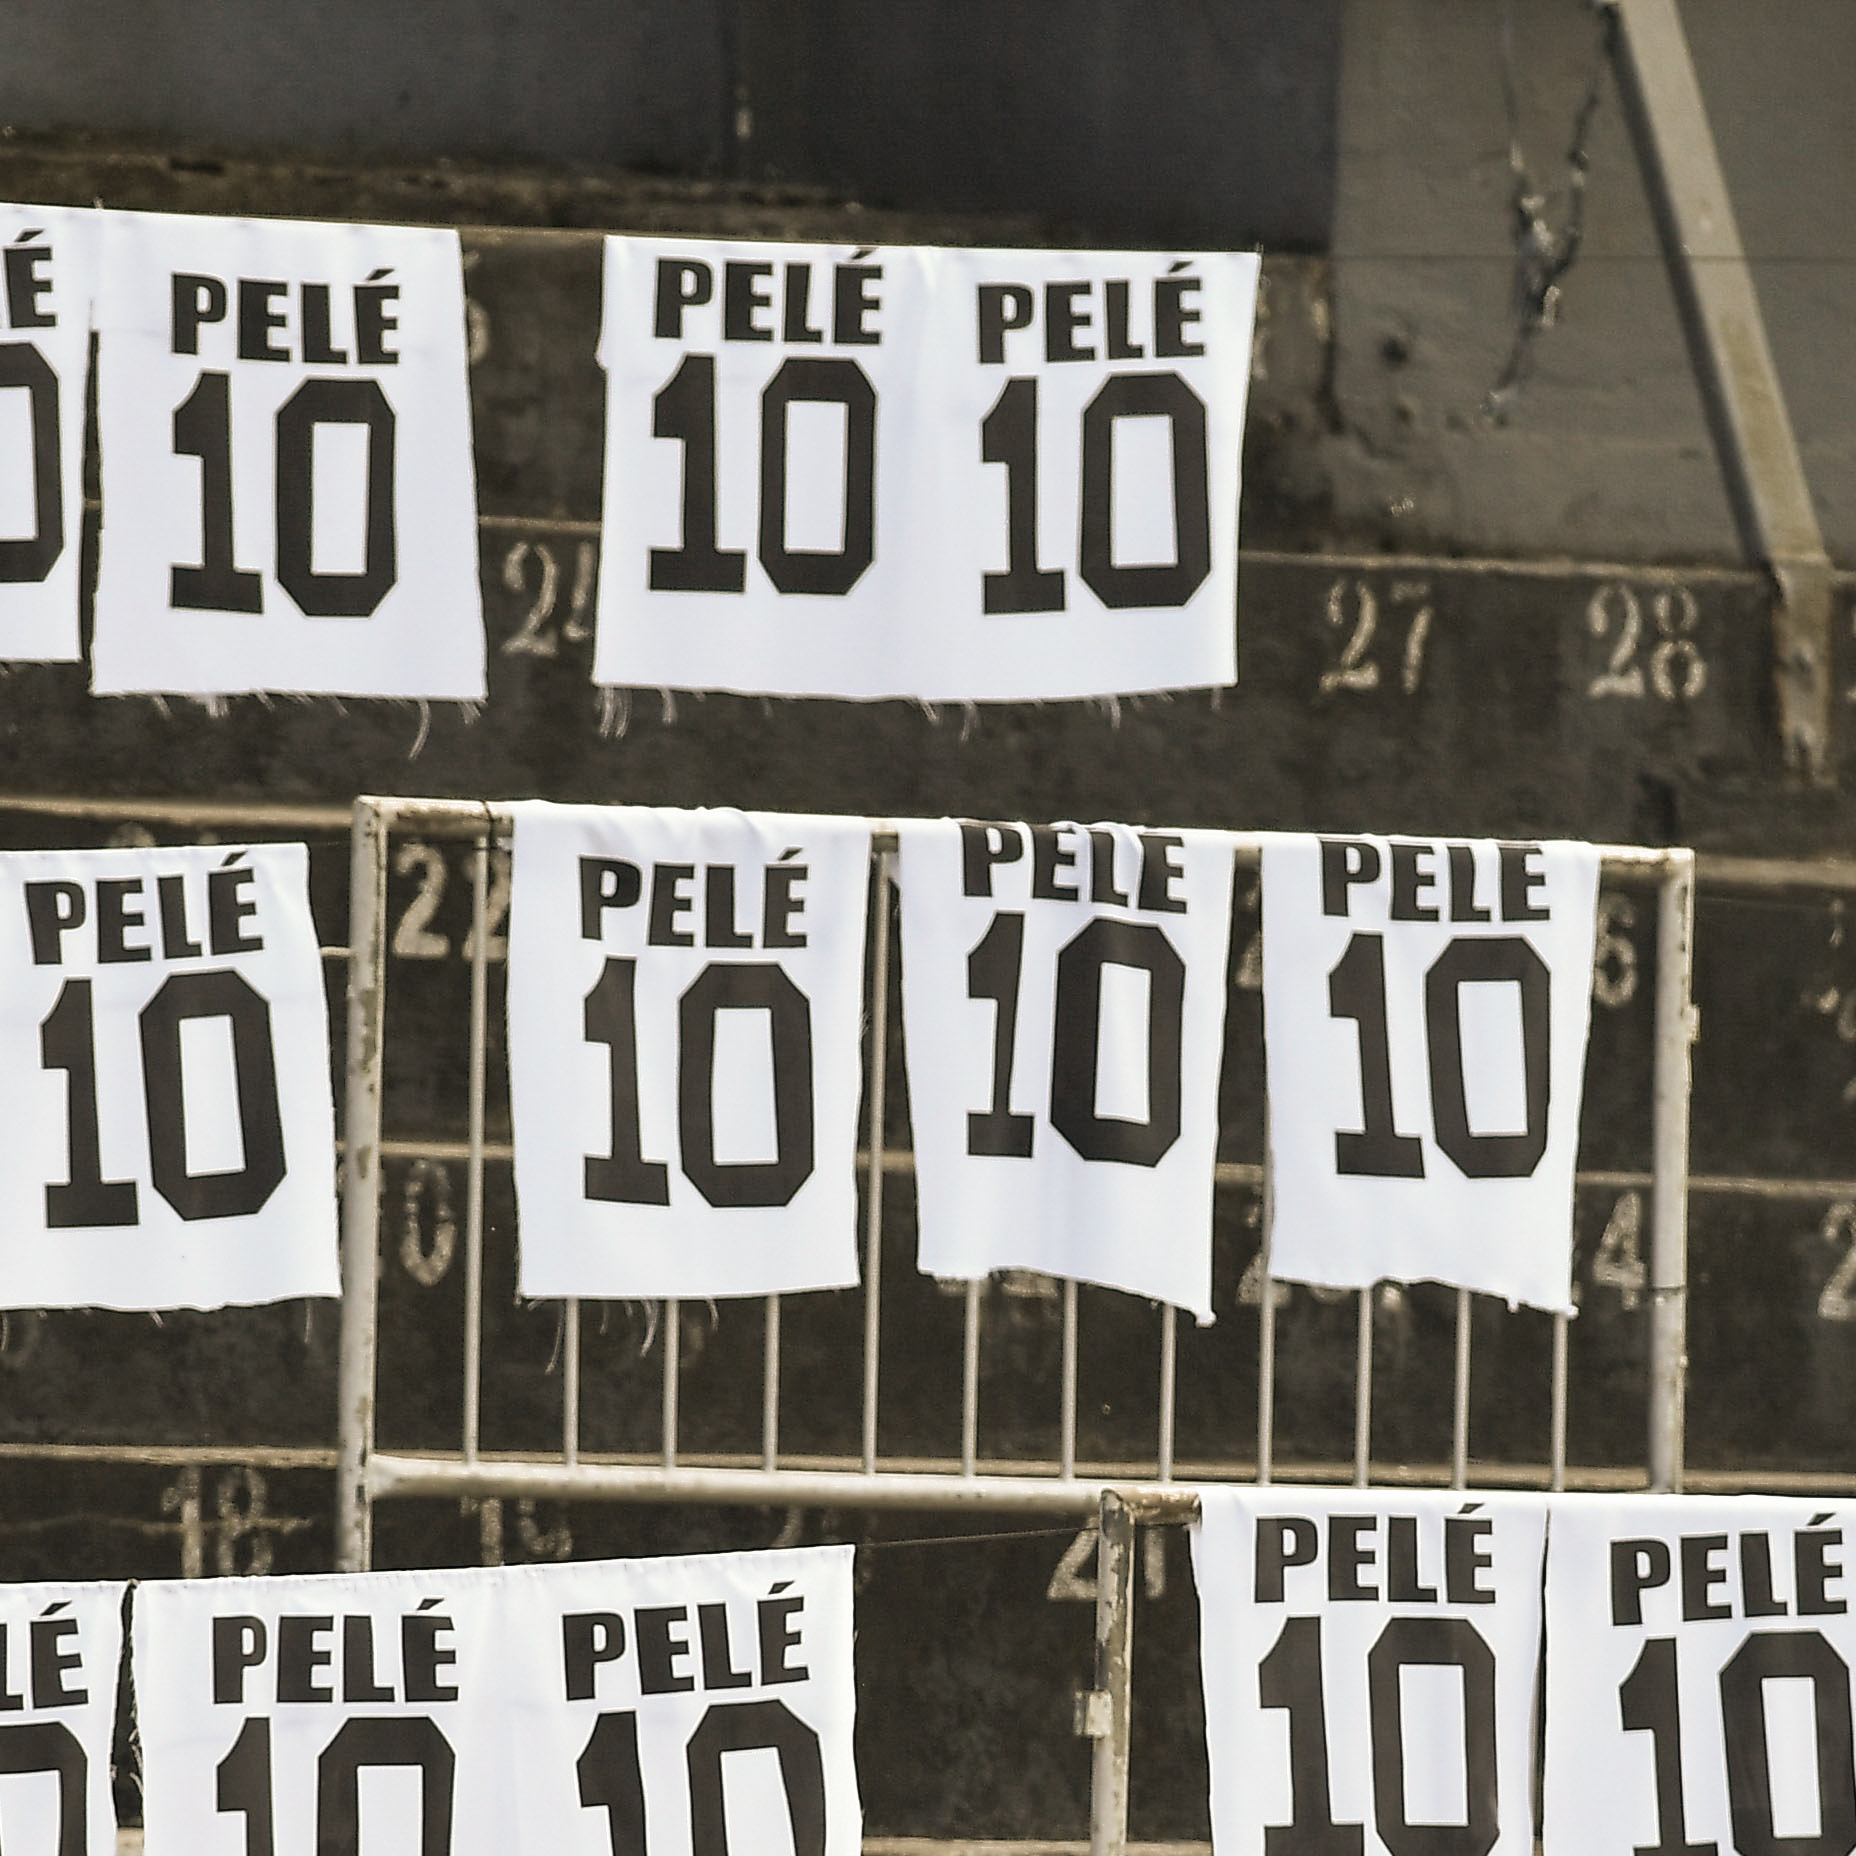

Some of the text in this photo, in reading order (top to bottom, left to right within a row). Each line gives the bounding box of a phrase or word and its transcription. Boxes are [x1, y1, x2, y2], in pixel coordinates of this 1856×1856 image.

[170, 267, 401, 366] PELÉ
[653, 245, 884, 346] PELÉ
[976, 260, 1206, 365] PELÉ
[168, 370, 398, 619] 10
[648, 353, 878, 597] 10
[980, 371, 1212, 616] 10
[1321, 580, 1433, 696] 27
[1586, 583, 1708, 702] 28
[23, 851, 265, 966] PELÉ
[578, 845, 810, 950] PELÉ
[583, 955, 816, 1210] 10
[966, 910, 1187, 1169] 10
[1327, 931, 1552, 1180] 10
[39, 968, 288, 1230] 10
[1253, 1501, 1497, 1606] PELÉ
[1609, 1511, 1850, 1628] PELÉ
[211, 1597, 460, 1706] PELÉ
[561, 1579, 811, 1703] PELÉ
